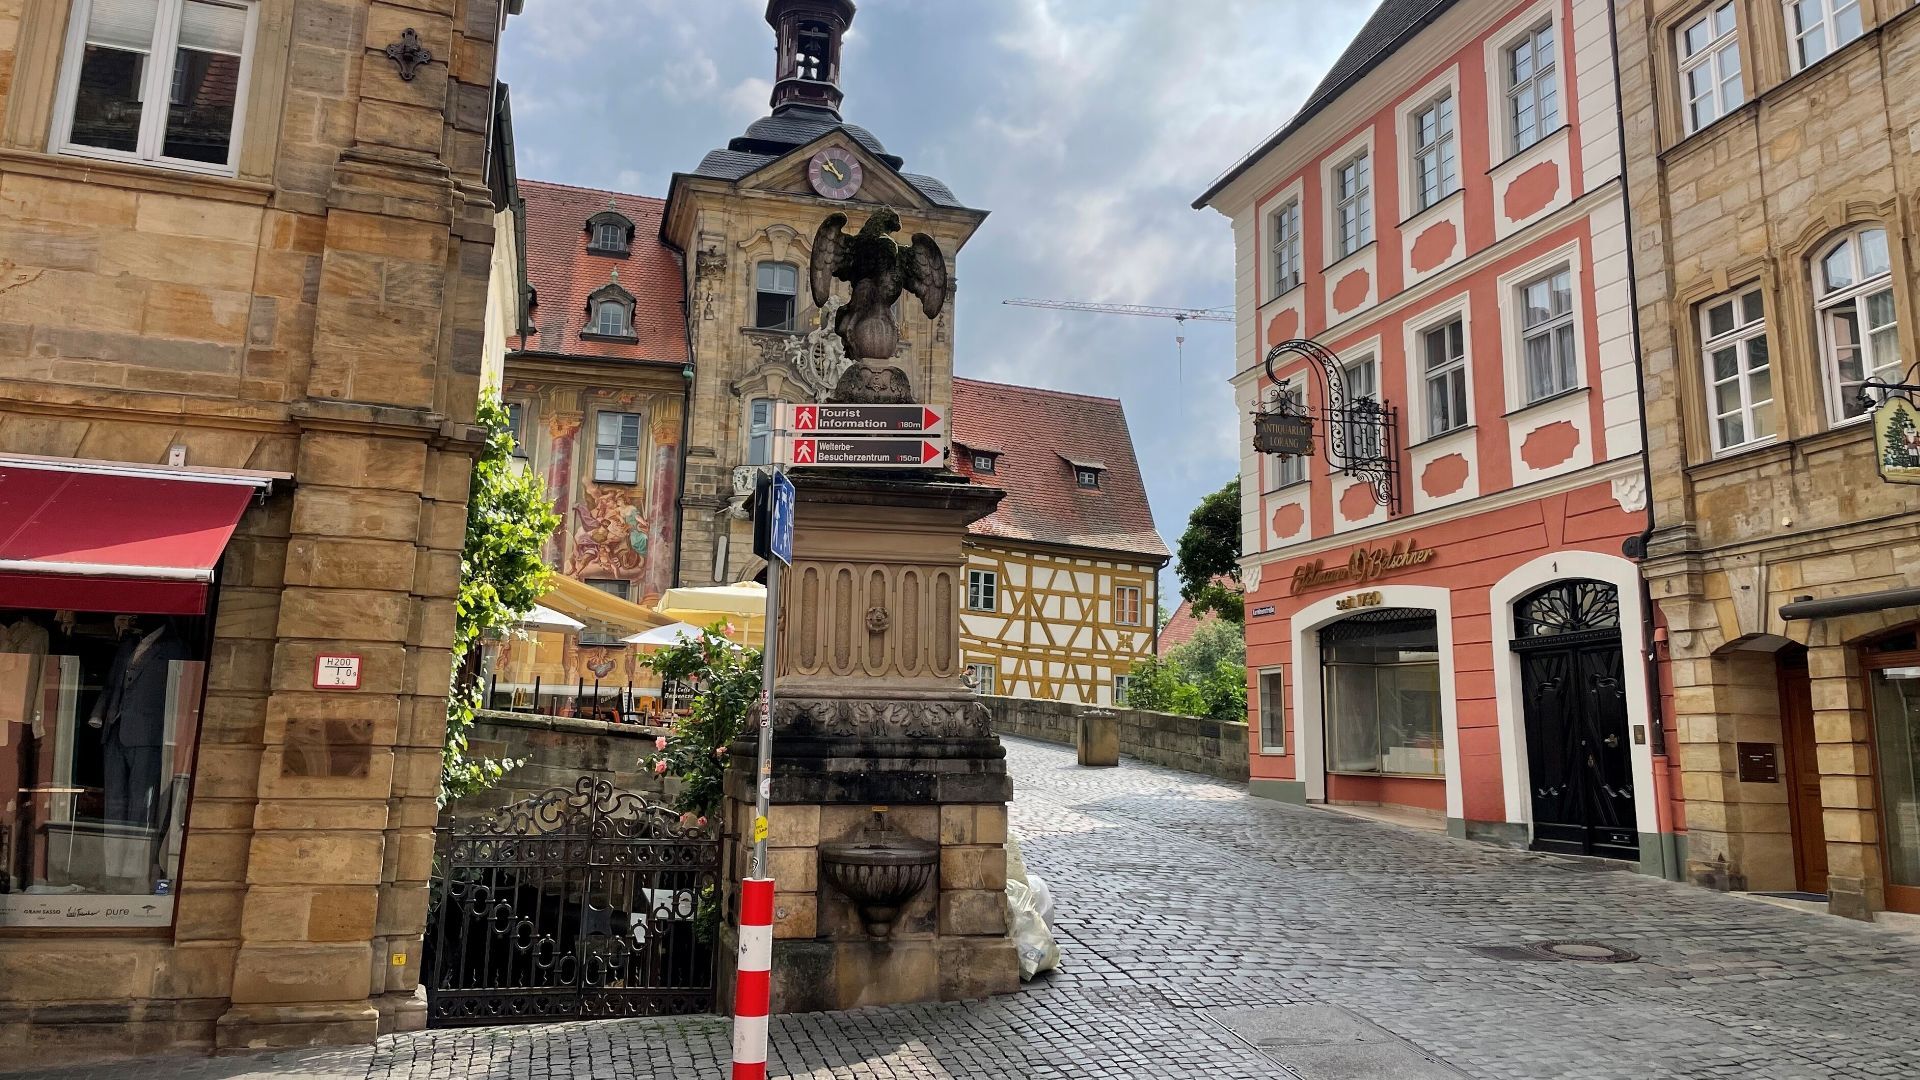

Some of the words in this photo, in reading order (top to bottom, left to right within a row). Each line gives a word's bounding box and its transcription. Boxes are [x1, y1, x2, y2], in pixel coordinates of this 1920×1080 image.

[821, 409, 861, 418] Tourist
[819, 419, 887, 428] Information
[1263, 423, 1306, 436] ANTIQUARIAT
[819, 442, 855, 451] Welterbe-
[818, 452, 890, 461] Besucherzentrum
[1552, 561, 1558, 573] 1
[327, 657, 351, 666] H200
[105, 908, 130, 917] pure
